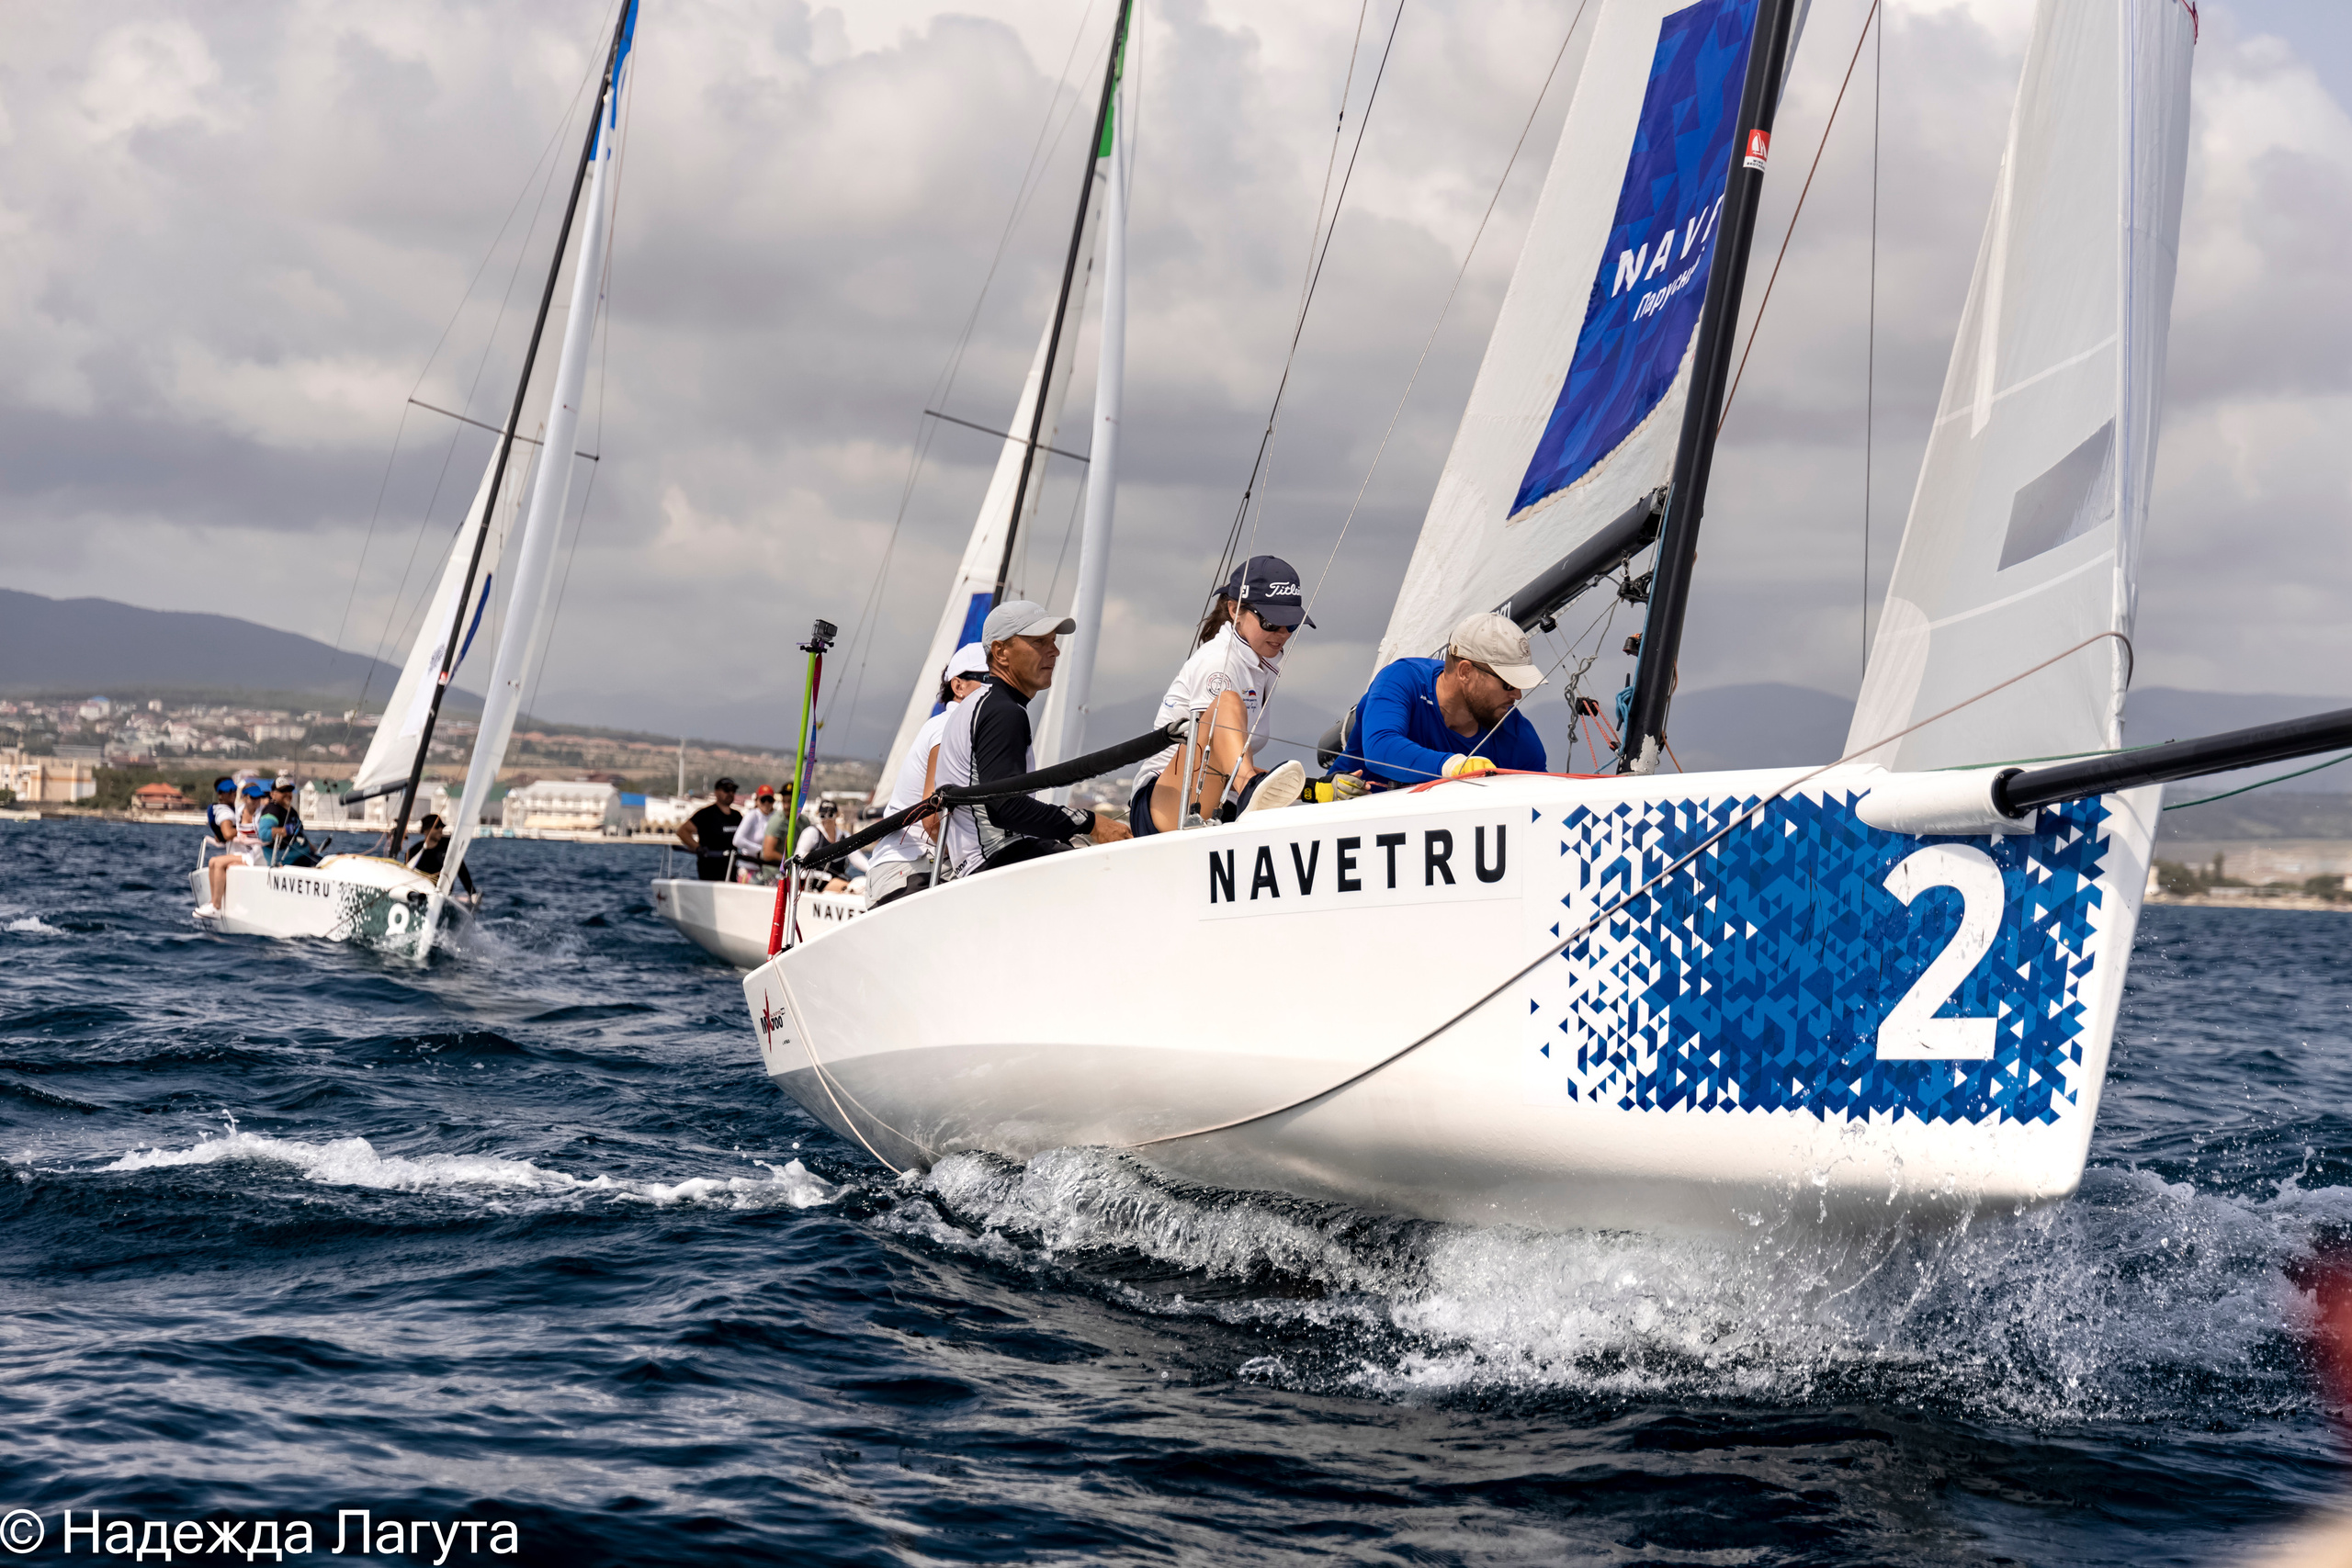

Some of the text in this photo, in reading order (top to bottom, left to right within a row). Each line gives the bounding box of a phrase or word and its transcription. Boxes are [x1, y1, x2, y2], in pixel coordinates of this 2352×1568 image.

[273, 875, 330, 897] NAVETRU
[1208, 824, 1507, 904] NAVETRU
[1876, 842, 2005, 1061] 2
